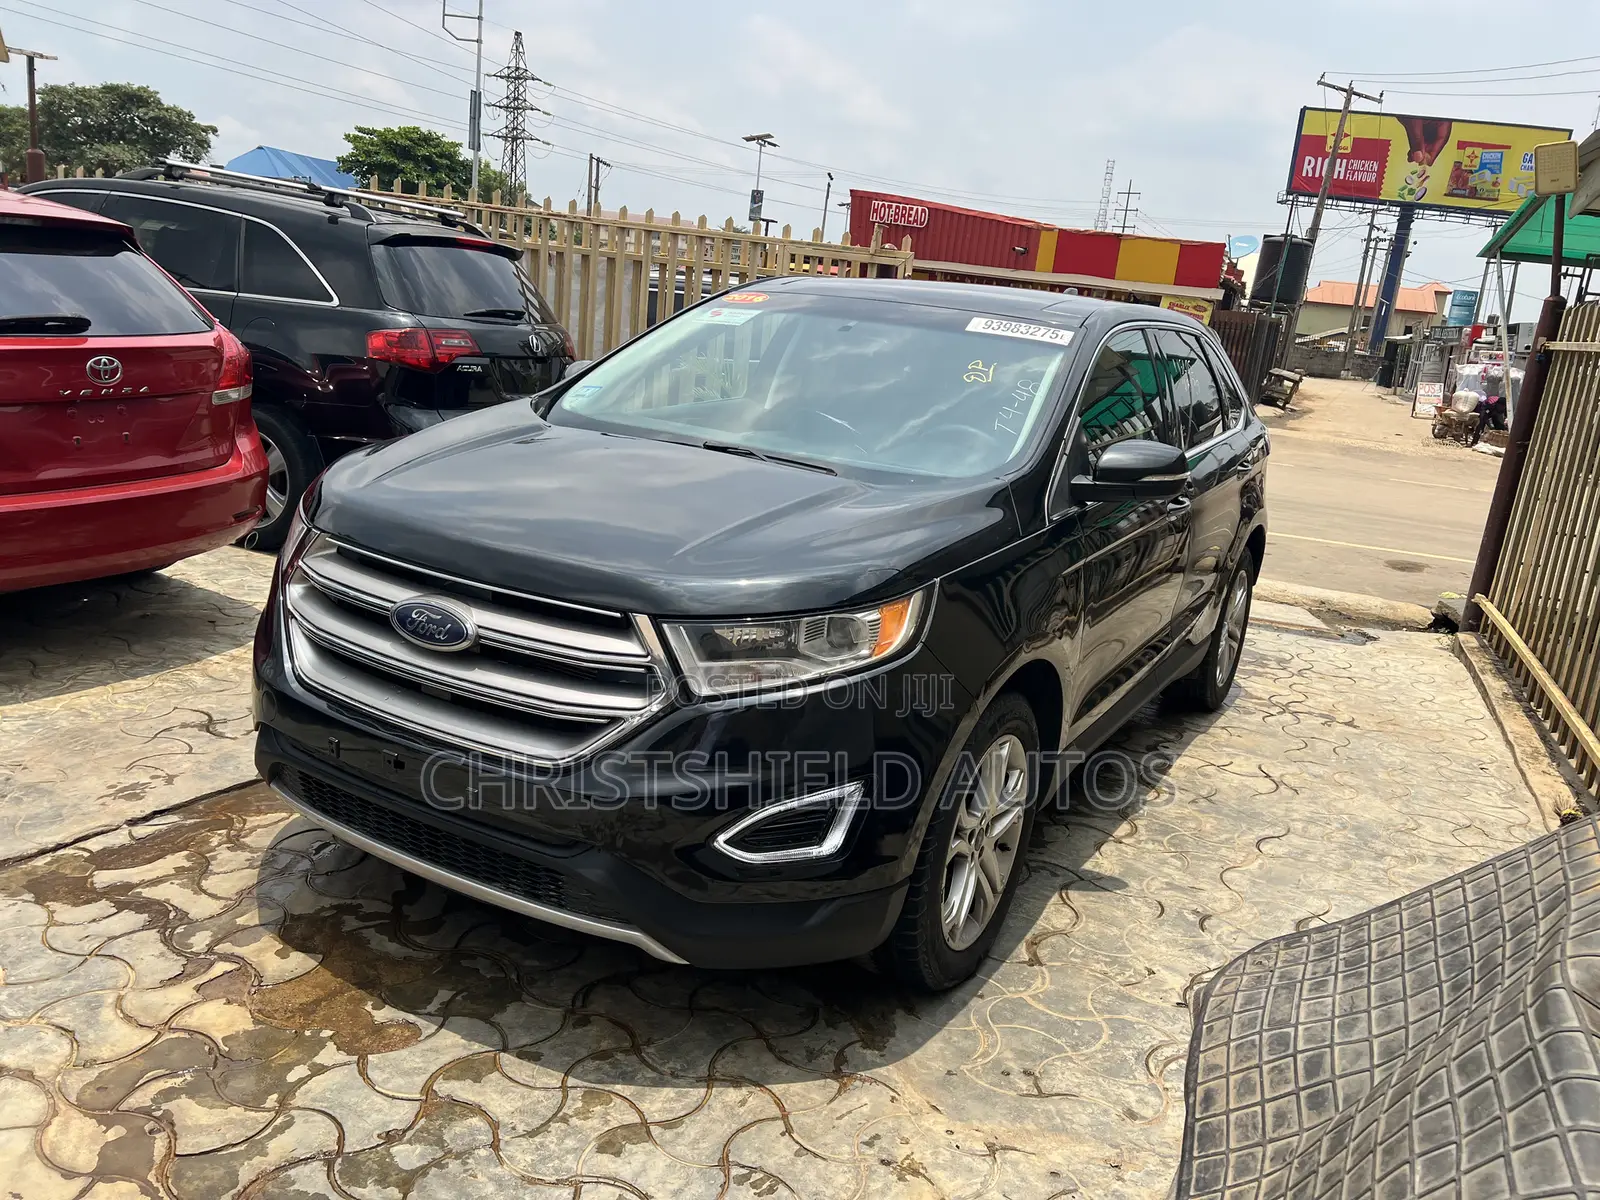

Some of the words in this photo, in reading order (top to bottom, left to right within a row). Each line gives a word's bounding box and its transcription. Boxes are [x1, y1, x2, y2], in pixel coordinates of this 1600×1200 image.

[1348, 159, 1379, 172] CHICKEN
[1346, 170, 1377, 183] FLAVOUR
[893, 203, 929, 227] BREAD
[1456, 293, 1477, 301] Ecobank
[982, 320, 1061, 340] 93983275
[456, 365, 483, 373] ACURA
[59, 386, 150, 396] VENZA
[1419, 384, 1437, 394] POS
[406, 608, 452, 640] Ford
